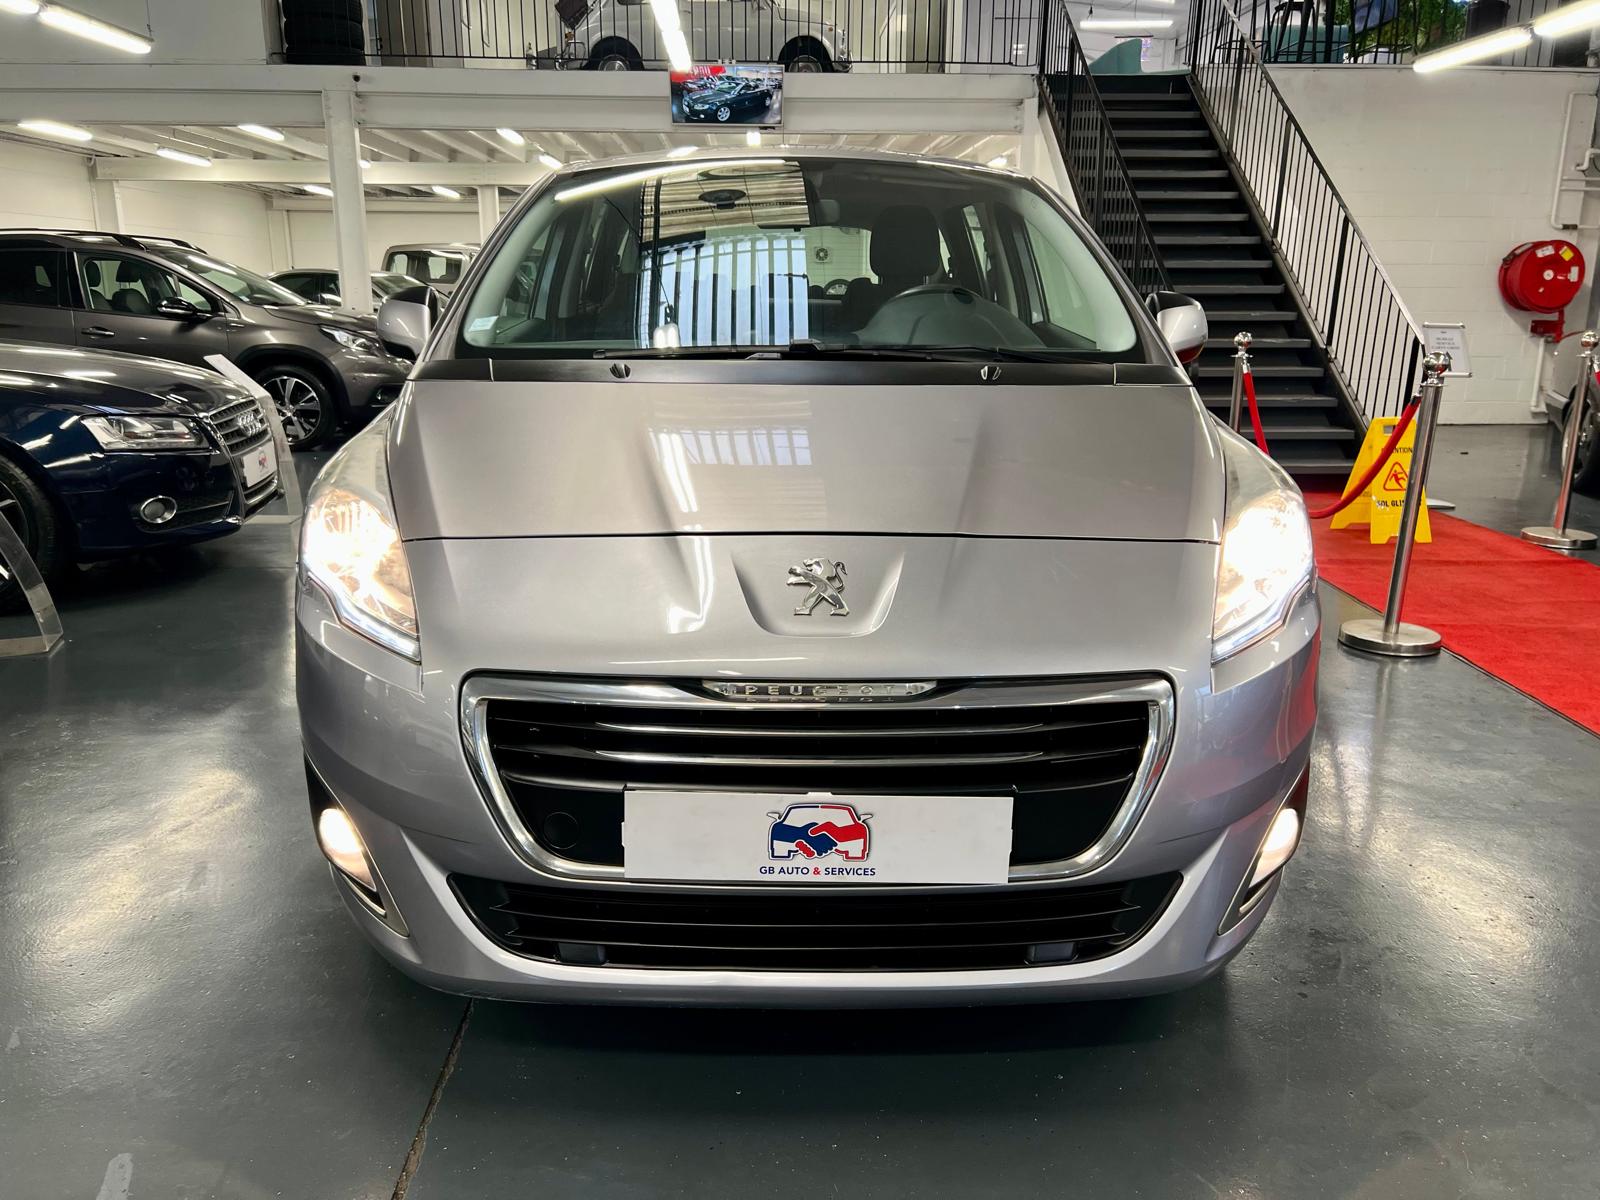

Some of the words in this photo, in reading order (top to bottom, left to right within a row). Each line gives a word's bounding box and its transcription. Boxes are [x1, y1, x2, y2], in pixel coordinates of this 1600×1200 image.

[744, 684, 895, 696] PEUGEOT
[759, 866, 775, 875] GB
[778, 866, 810, 875] AUTO
[812, 866, 821, 876] &
[824, 867, 876, 876] SERVICES
